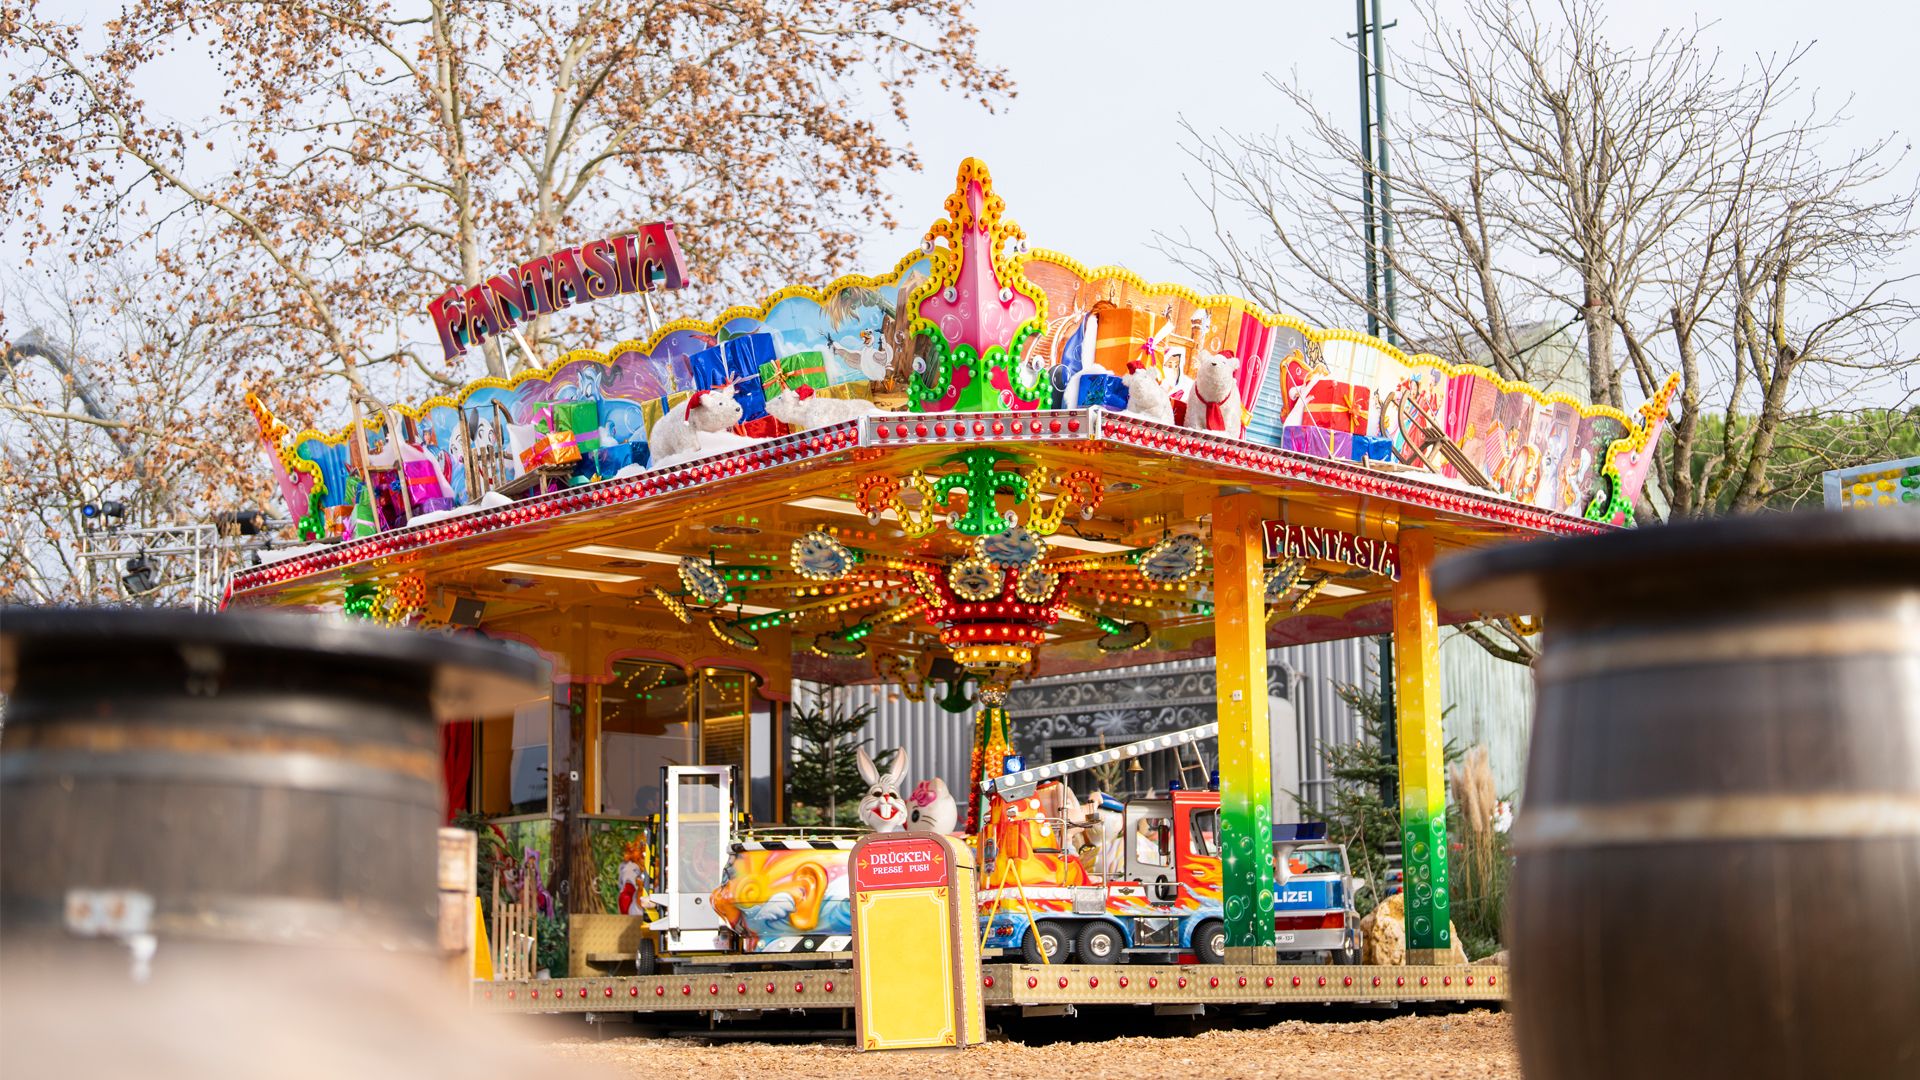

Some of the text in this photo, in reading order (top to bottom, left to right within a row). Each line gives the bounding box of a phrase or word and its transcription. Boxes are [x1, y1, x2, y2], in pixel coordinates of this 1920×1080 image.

[427, 220, 689, 366] FANTASIA
[1262, 519, 1401, 582] FANTASIA
[870, 850, 931, 865] DRÜCKEN
[873, 864, 930, 875] PRESSE PUSH
[1274, 890, 1312, 903] LIZEI
